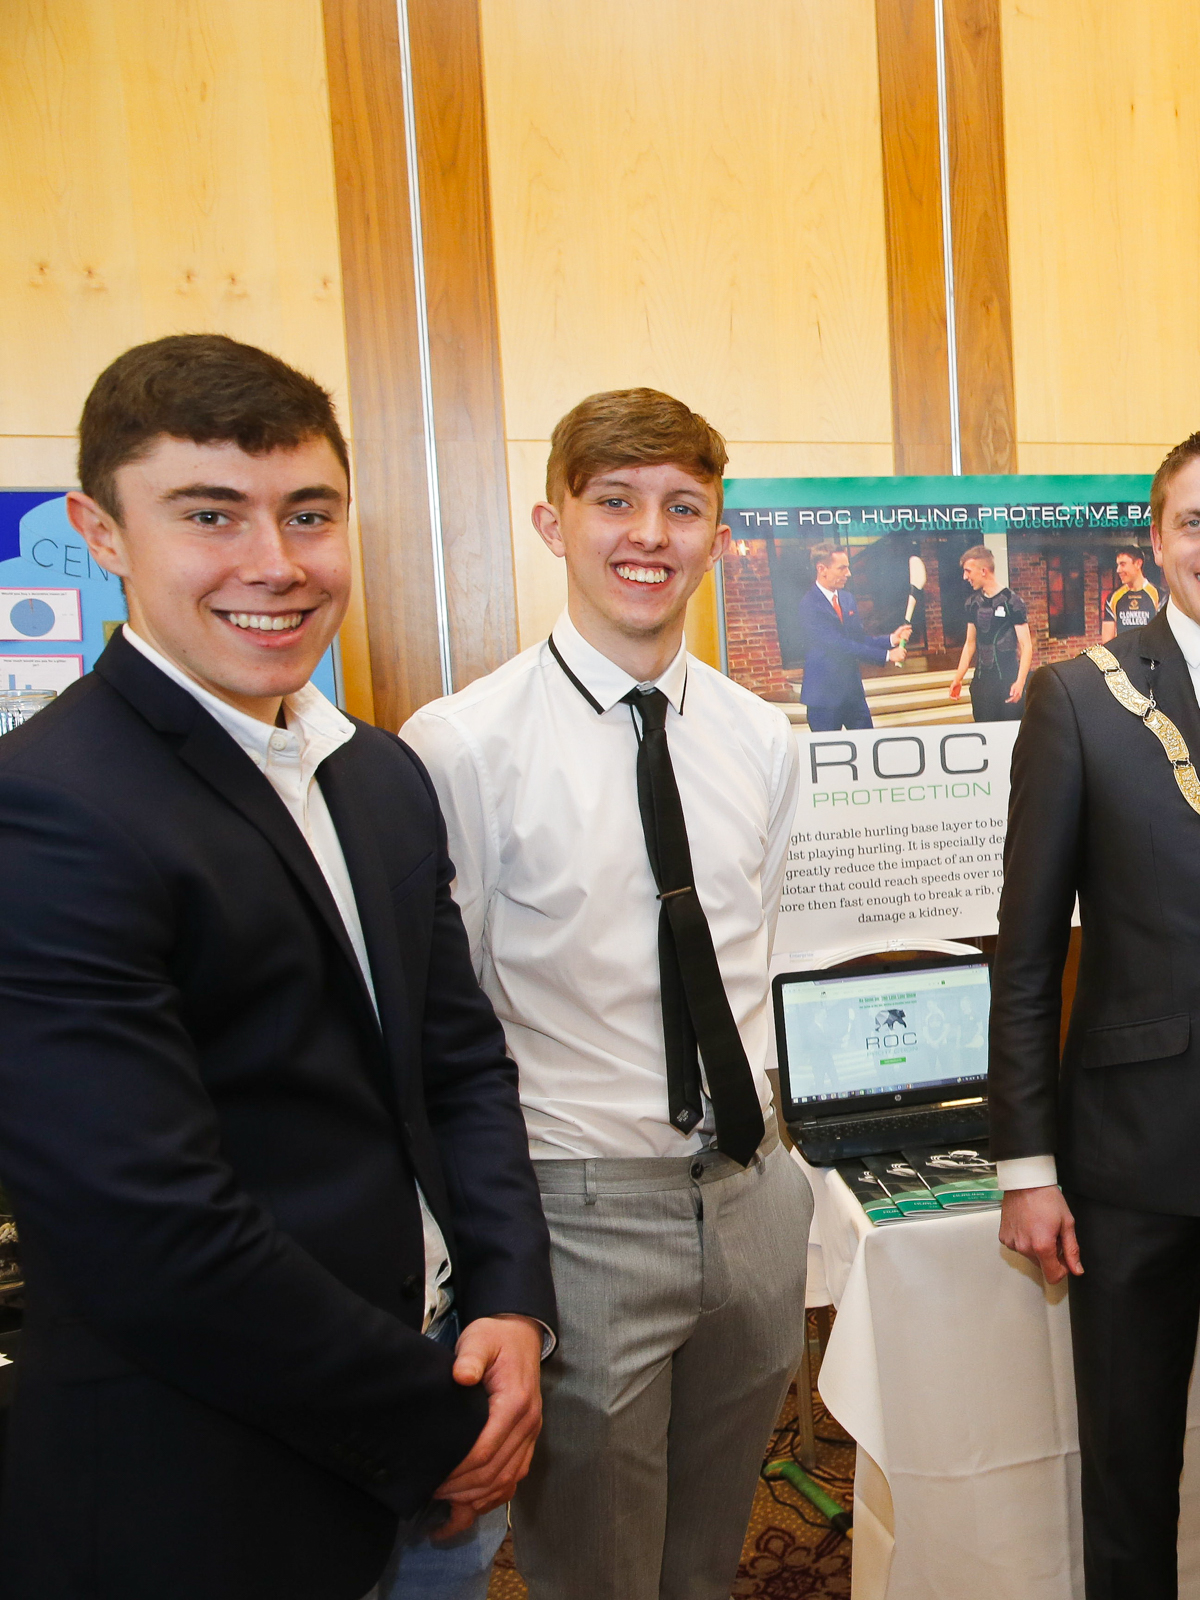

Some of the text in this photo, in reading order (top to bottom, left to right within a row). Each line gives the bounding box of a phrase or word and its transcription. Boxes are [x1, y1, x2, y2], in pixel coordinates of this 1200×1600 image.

[740, 504, 1151, 526] THE ROC HURLING PROTECTIVE BA
[1088, 513, 1129, 528] Base
[1132, 513, 1151, 527] La
[32, 538, 109, 581] CEN
[1119, 610, 1150, 620] CLONKEEN
[1121, 618, 1148, 626] COLLEGE
[809, 732, 989, 784] ROC
[812, 781, 991, 808] PROTECTION
[790, 818, 1004, 846] ght durable hurling base layer to be
[787, 835, 1005, 861] lst playing hurling. It is specially des
[785, 865, 831, 880] greatly
[834, 862, 875, 875] reduce
[878, 860, 898, 871] the
[901, 855, 942, 869] impact
[944, 853, 958, 864] of
[959, 855, 974, 863] an
[976, 853, 991, 862] on
[782, 869, 1003, 896] liotar that could reach speeds over 10
[808, 900, 837, 910] then
[840, 896, 864, 908] fast
[866, 892, 911, 907] enough
[914, 890, 926, 901] to
[928, 887, 963, 900] break
[965, 888, 973, 897] a
[858, 906, 963, 923] damage a kidney.
[865, 1032, 917, 1050] ROC
